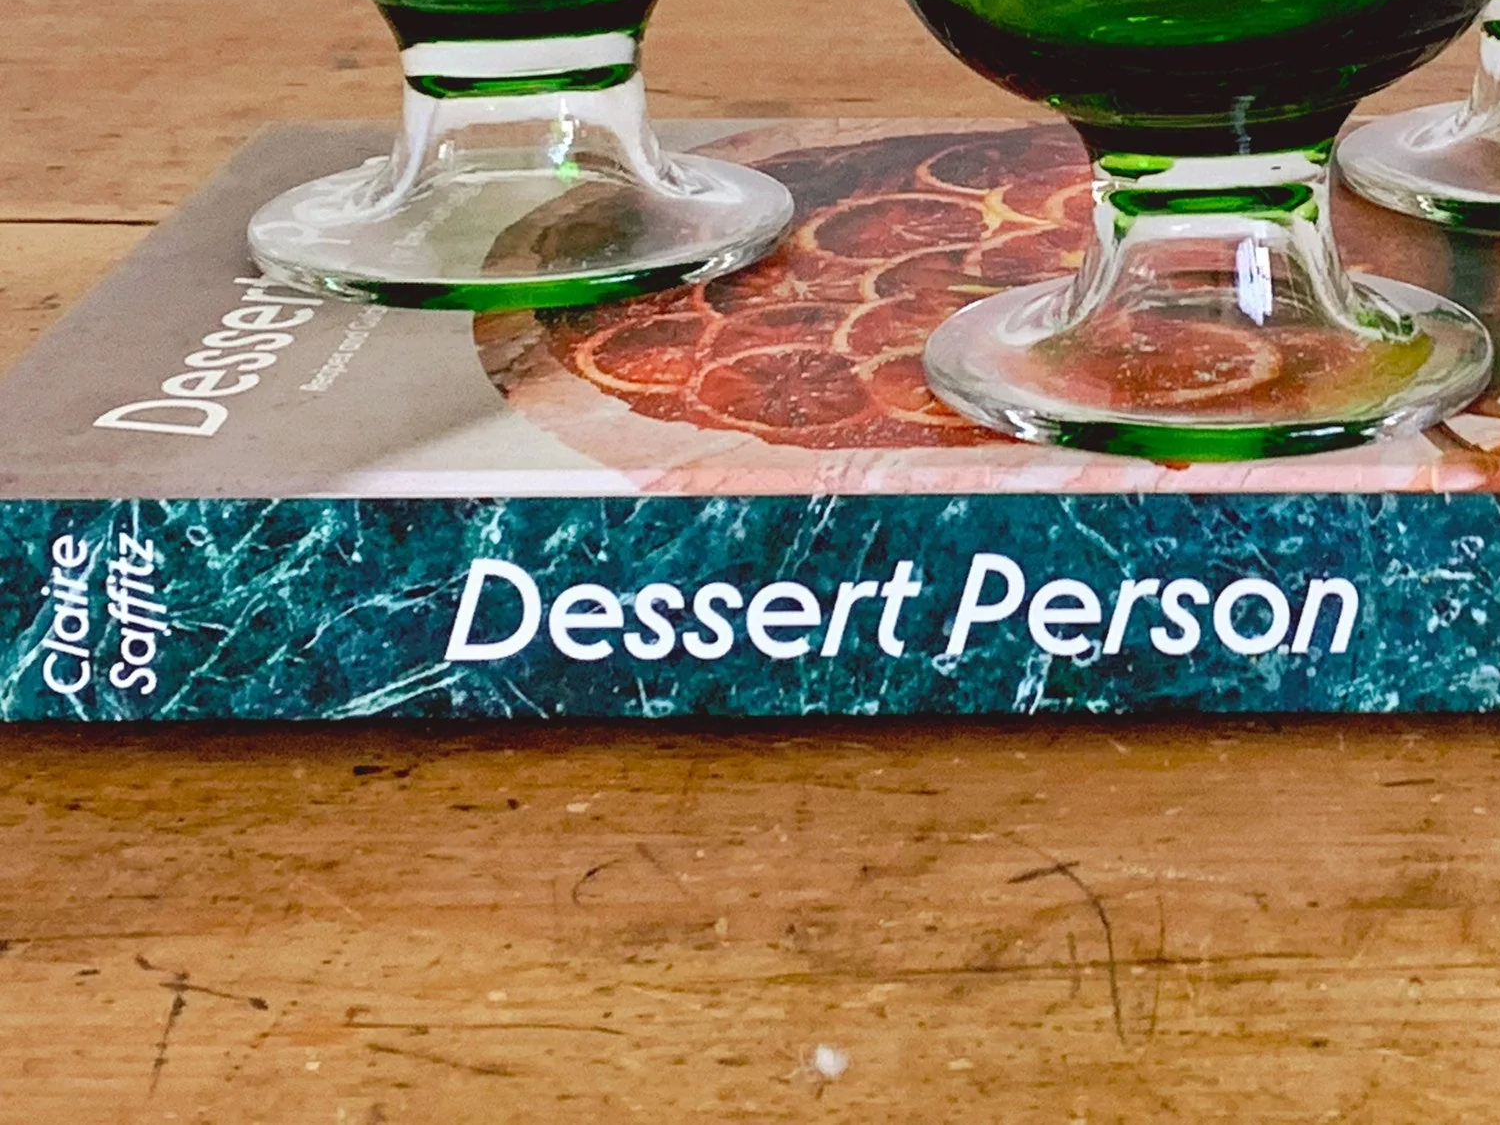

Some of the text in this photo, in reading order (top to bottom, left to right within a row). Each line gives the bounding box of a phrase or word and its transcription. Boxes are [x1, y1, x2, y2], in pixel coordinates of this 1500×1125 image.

[41, 534, 91, 694] Claire
[107, 532, 172, 695] Saffitz
[444, 553, 1359, 661] Dessert Person
